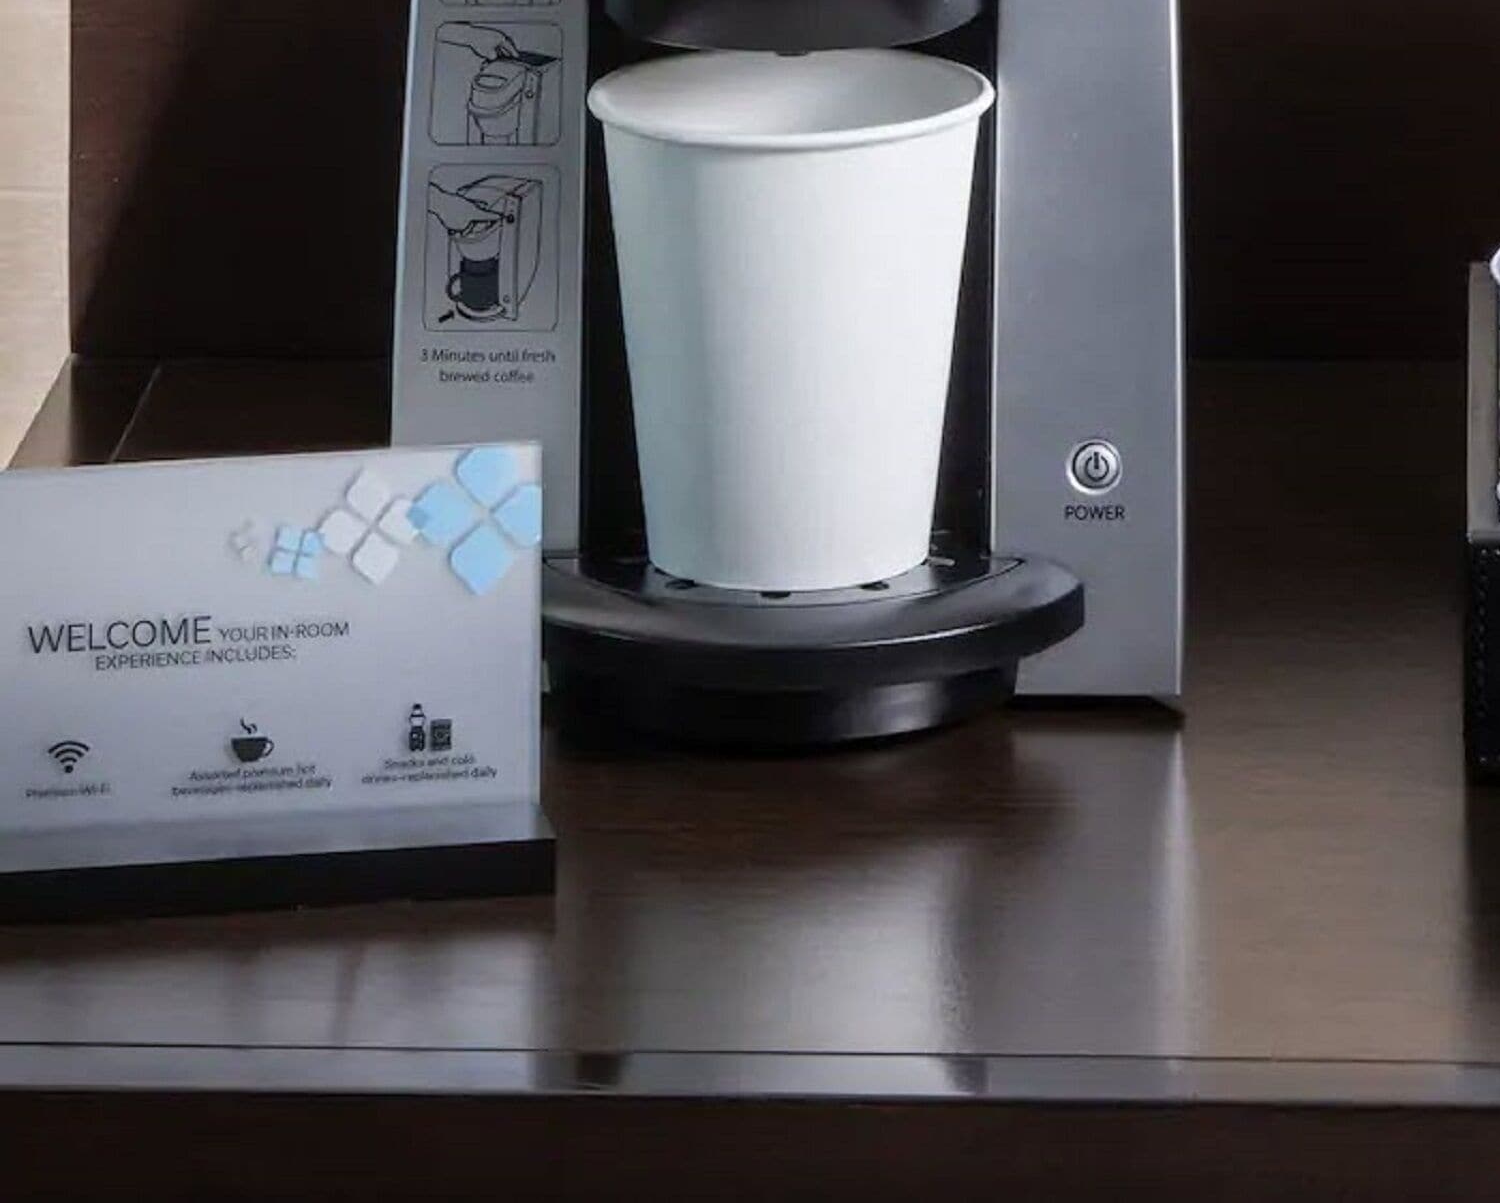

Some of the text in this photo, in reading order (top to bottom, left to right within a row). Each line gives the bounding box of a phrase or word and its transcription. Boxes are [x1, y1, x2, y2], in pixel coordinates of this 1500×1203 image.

[421, 348, 556, 363] 3 Minutes until fresh
[438, 369, 536, 384] brewed coffee
[1064, 504, 1126, 521] POWER
[27, 615, 350, 654] WELCOME YOUR IN-ROOM
[94, 643, 298, 672] EXPERIENCE INCLUDES:
